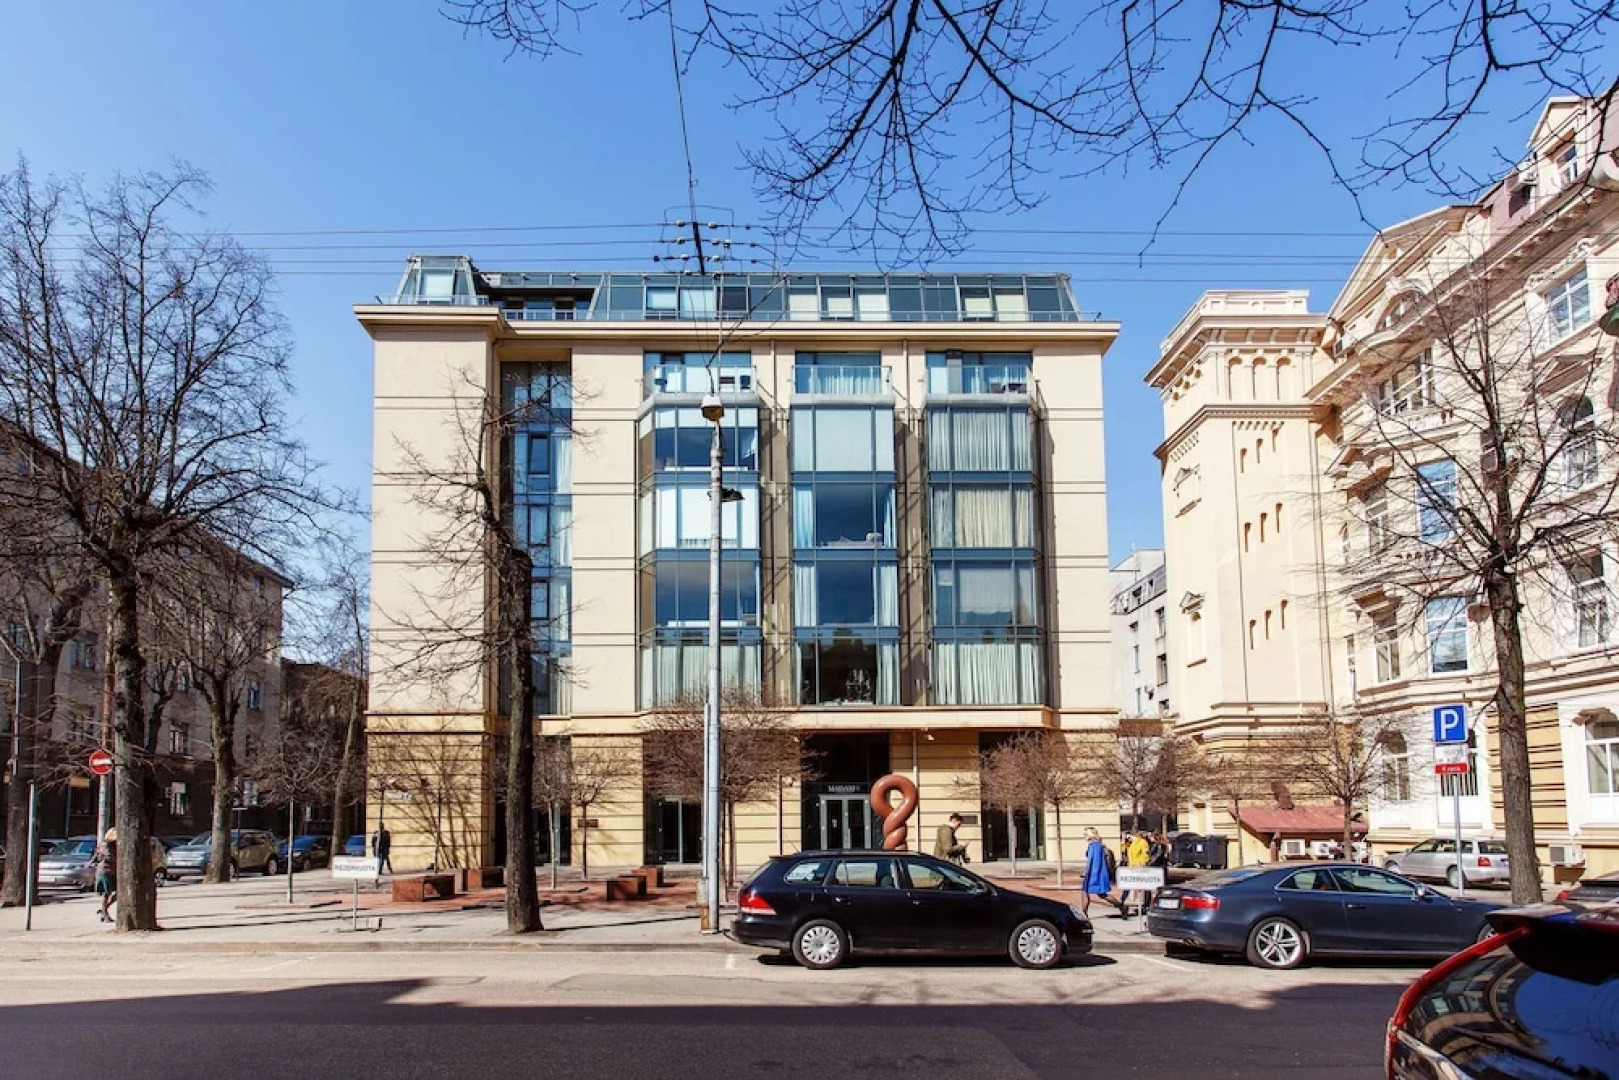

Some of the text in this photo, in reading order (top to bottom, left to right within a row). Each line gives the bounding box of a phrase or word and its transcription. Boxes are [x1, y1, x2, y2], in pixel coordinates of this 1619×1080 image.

[1440, 708, 1459, 740] P
[334, 864, 376, 872] REZERVUOTA
[1120, 875, 1161, 883] REZERVUOTA
